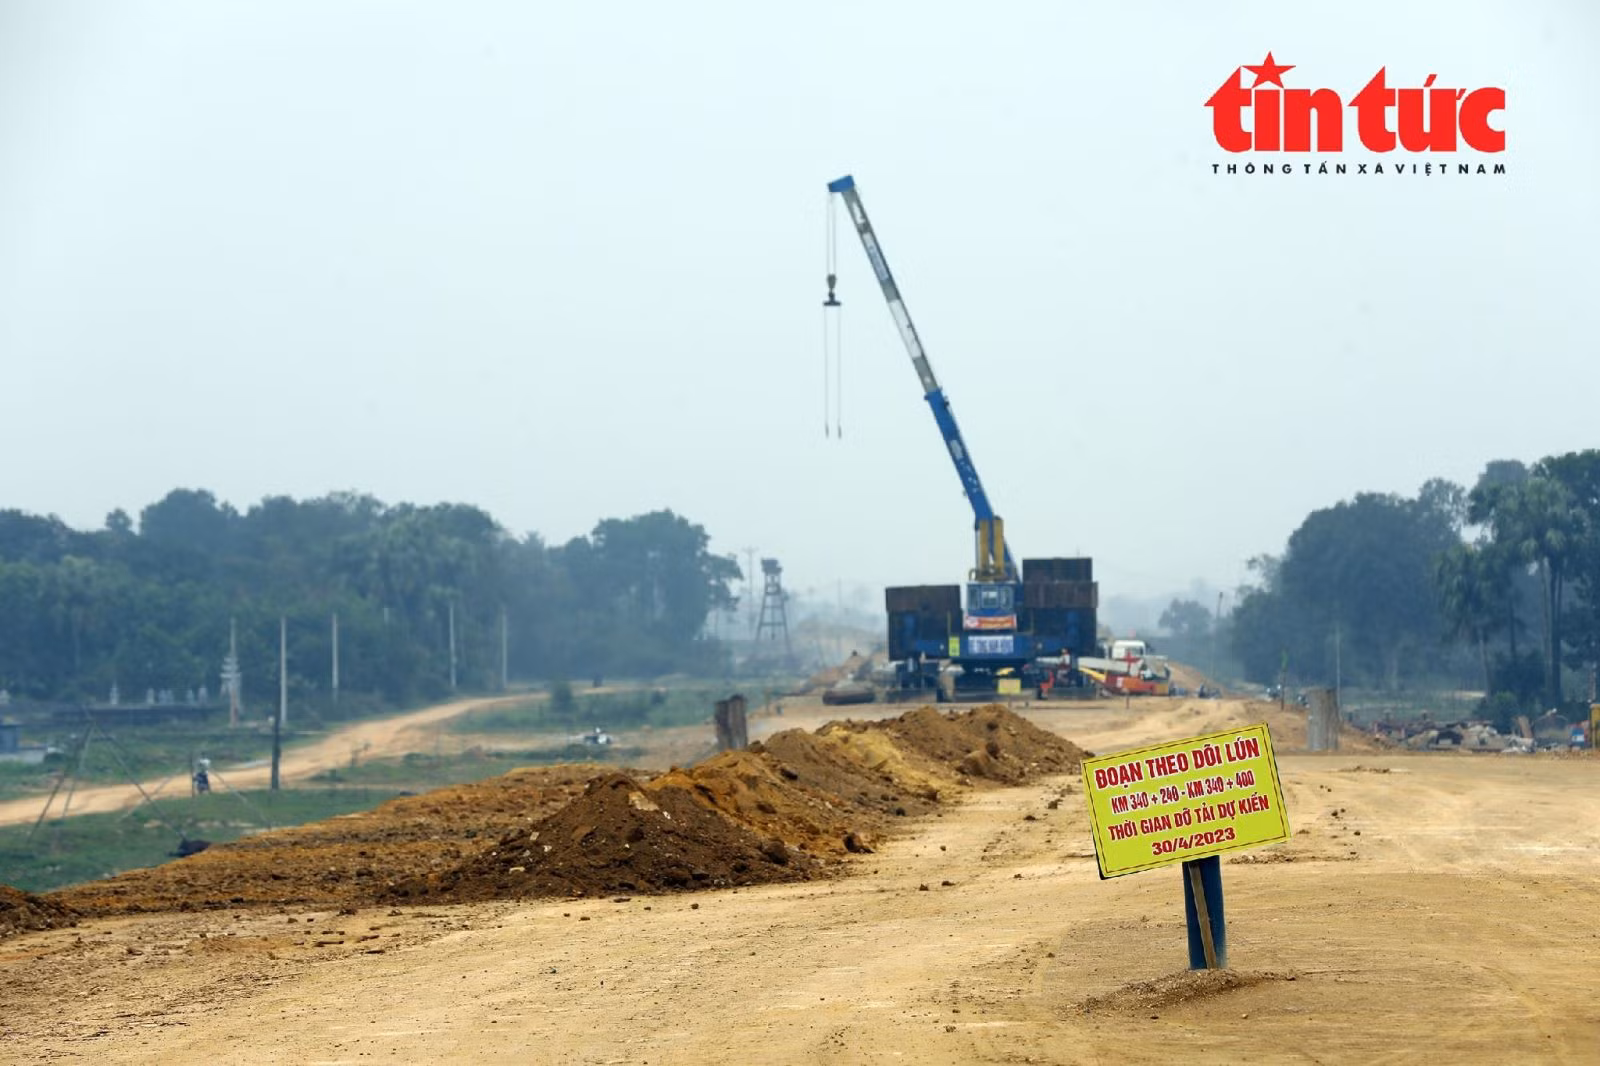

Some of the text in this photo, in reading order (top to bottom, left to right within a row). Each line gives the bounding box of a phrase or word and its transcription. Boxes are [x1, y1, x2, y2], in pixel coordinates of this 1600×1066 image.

[1095, 737, 1260, 788] ĐOẠN THEO DÕI LÚN
[1111, 795, 1129, 814] KM
[1130, 791, 1149, 810] 340
[1159, 786, 1179, 804] 240
[1186, 781, 1204, 799] KM
[1205, 777, 1224, 795] 340
[1235, 770, 1255, 788] 400
[1108, 820, 1137, 840] THỜI
[1140, 814, 1172, 834] GIAN
[1194, 802, 1215, 823] TẢI
[1217, 800, 1235, 821] DỰ
[1238, 792, 1270, 815] KIẾN
[1151, 827, 1236, 855] 30/4/2023
